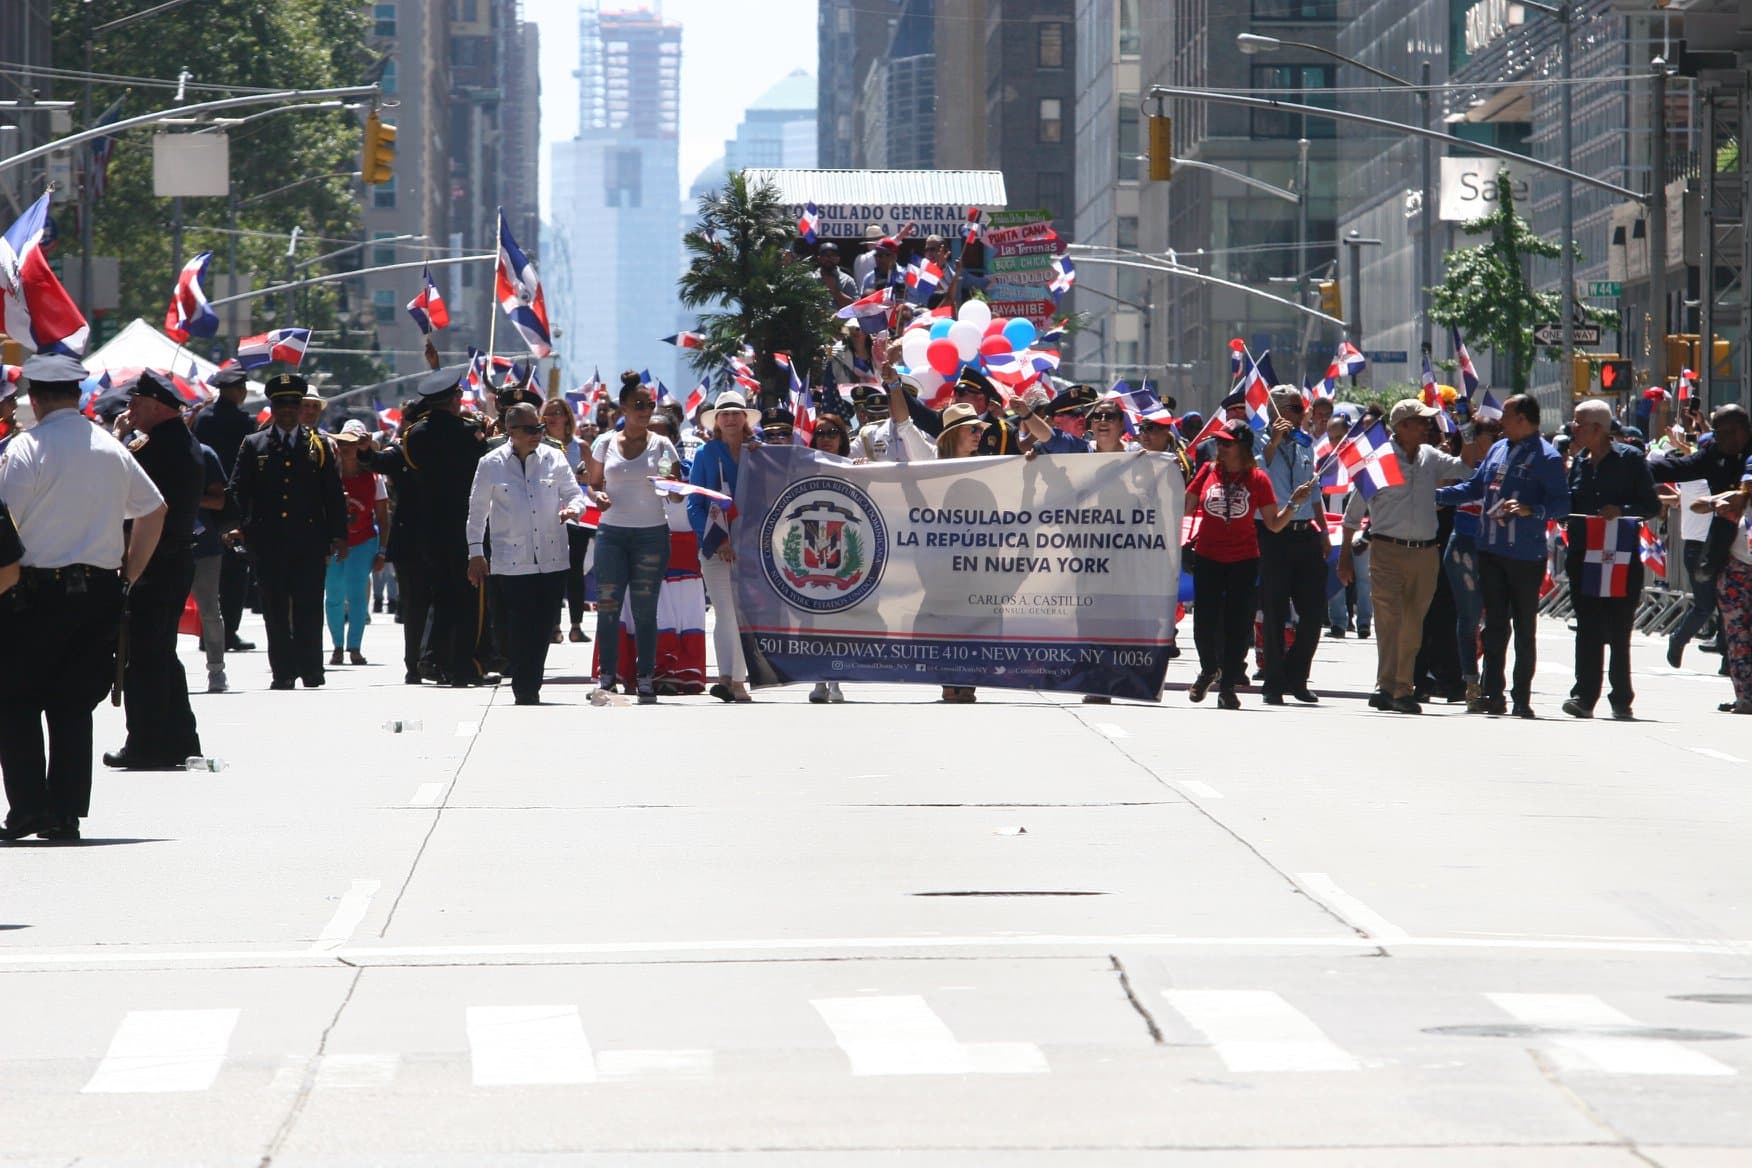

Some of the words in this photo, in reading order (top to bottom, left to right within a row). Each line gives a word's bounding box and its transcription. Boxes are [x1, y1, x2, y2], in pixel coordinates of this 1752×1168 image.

[1461, 172, 1528, 201] Sae
[784, 205, 884, 220] COSULADO
[890, 206, 966, 220] GENERAL
[988, 229, 1018, 243] PUNTA
[1022, 224, 1048, 238] CANA
[1600, 283, 1612, 296] 44
[1542, 330, 1564, 339] ONE
[1574, 329, 1595, 339] WAY
[909, 507, 1032, 526] CONSULADO
[1038, 509, 1126, 525] GENERAL
[1132, 509, 1156, 525] DE
[897, 531, 919, 547] LA
[926, 529, 1030, 548] REPÚBLICA
[1036, 533, 1166, 550] DOMINICANA
[952, 556, 978, 572] EN
[984, 557, 1051, 573] NUEVA
[1057, 557, 1110, 574] YORK
[968, 594, 1016, 606] CARLOS
[1033, 595, 1093, 607] CASTILLO
[993, 607, 1025, 615] CONSUL
[1029, 608, 1069, 616] GENERAL
[788, 639, 888, 658] BROADWAY,
[890, 643, 940, 660] SUITE
[942, 645, 968, 660] 410
[981, 646, 1019, 662] NEW
[1022, 647, 1076, 664] YORK,
[1080, 649, 1104, 664] NY
[1112, 650, 1153, 667] 10036
